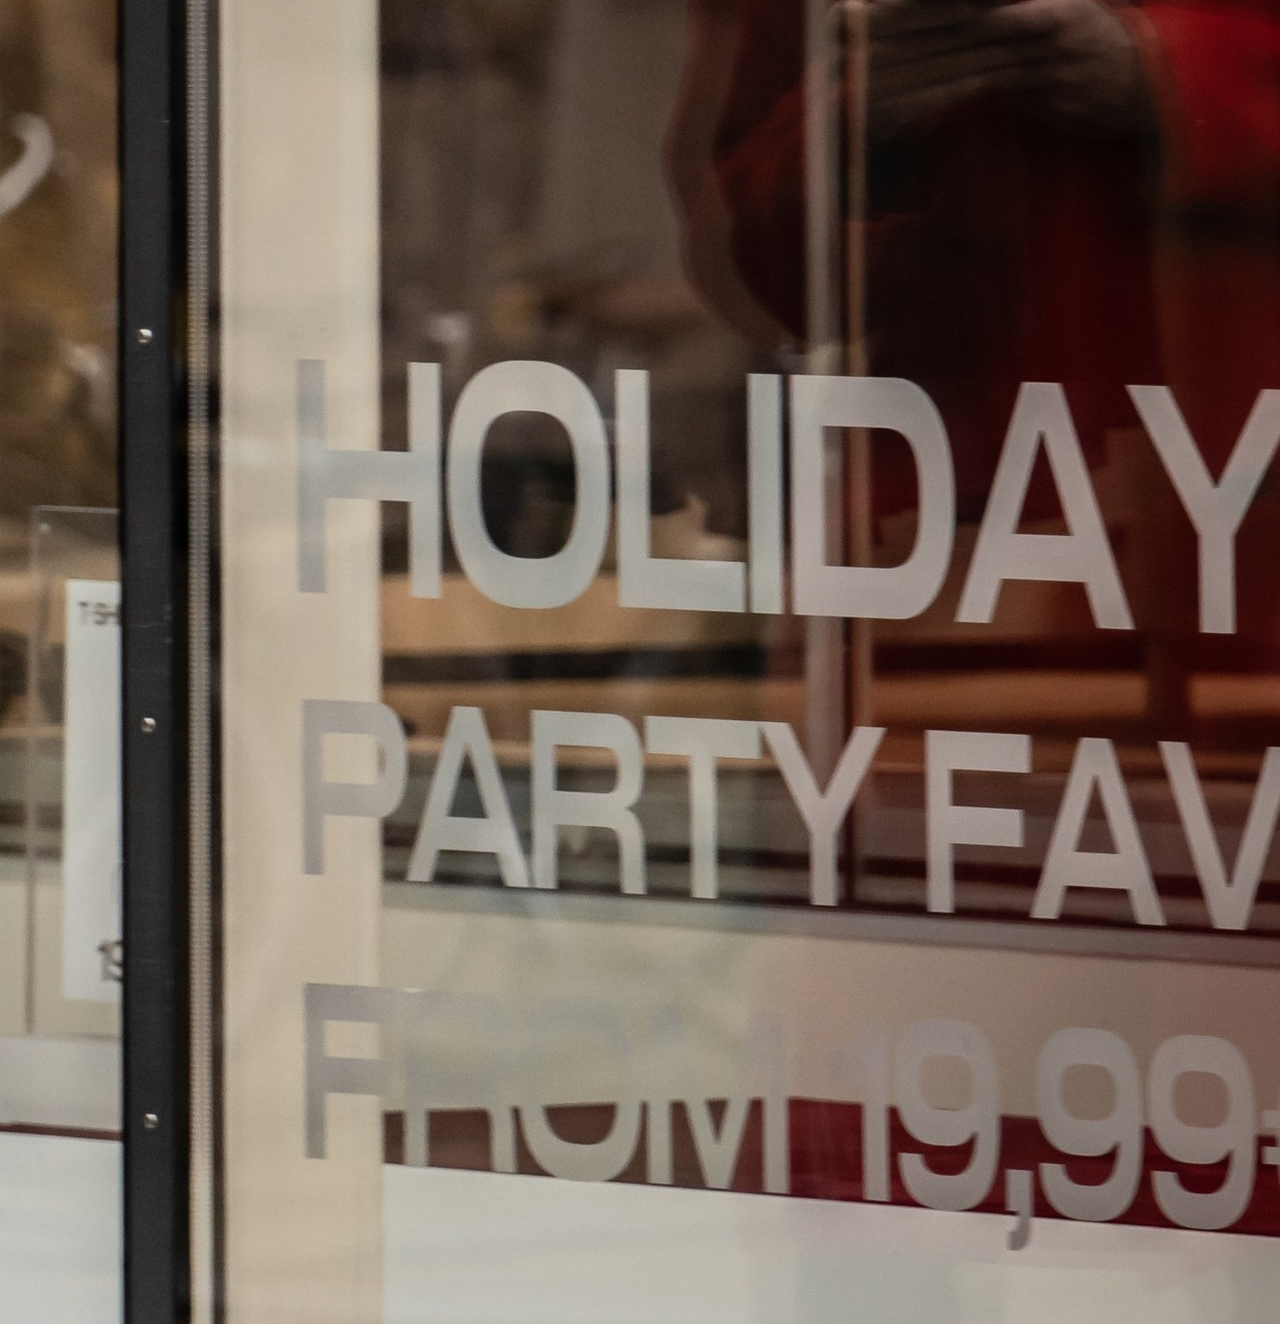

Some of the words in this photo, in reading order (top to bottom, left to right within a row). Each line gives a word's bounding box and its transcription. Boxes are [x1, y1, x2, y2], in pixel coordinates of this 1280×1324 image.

[296, 359, 1280, 634] HOLIDAY
[302, 698, 885, 907] PARTY
[924, 729, 1280, 931] FAV
[304, 982, 790, 1195] FROM
[833, 1018, 1280, 1251] 19,99
